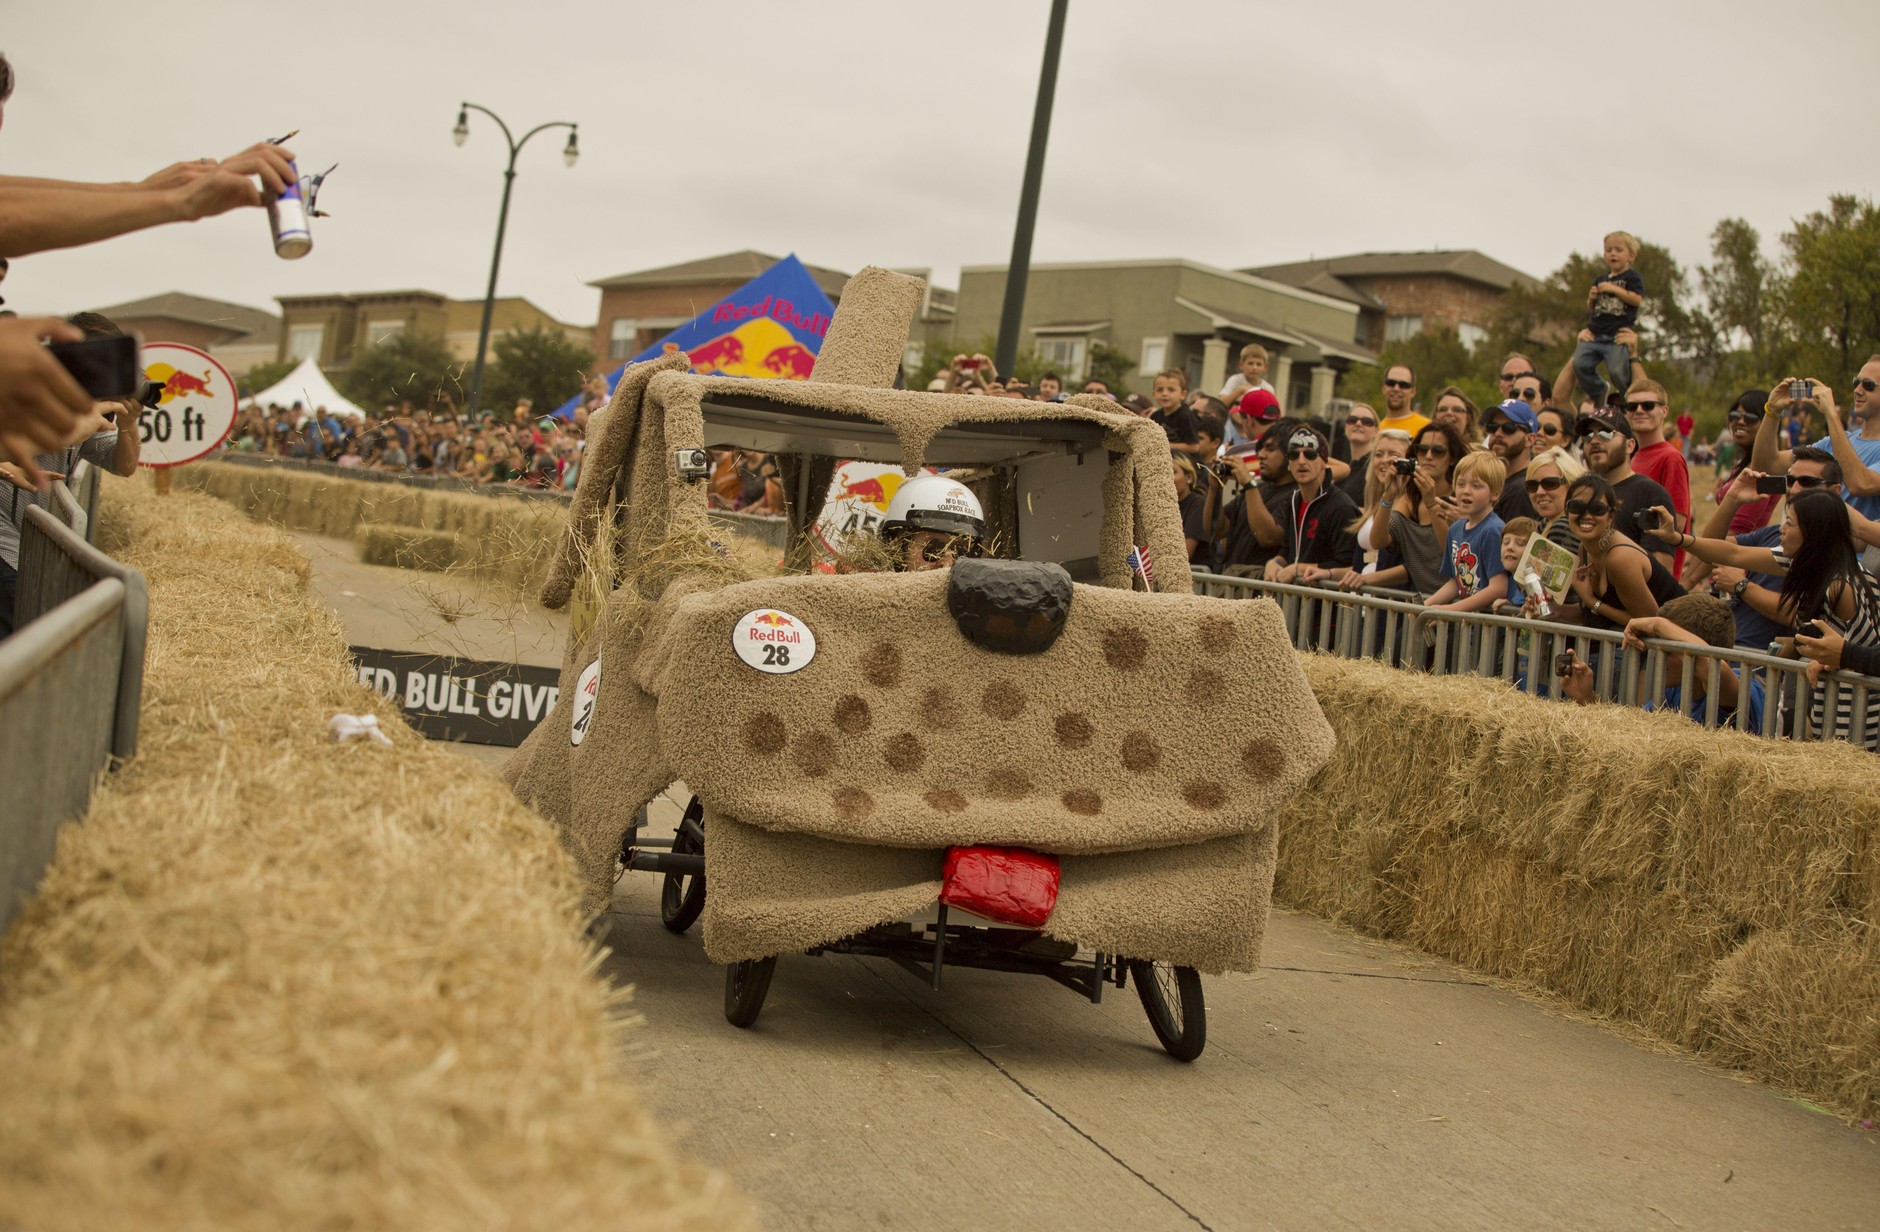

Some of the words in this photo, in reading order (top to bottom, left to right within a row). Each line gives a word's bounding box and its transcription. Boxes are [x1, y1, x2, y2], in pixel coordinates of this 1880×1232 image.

[713, 295, 773, 324] Red
[772, 298, 834, 338] Bull
[182, 406, 205, 442] ft
[937, 504, 964, 513] SOAPBOX
[964, 507, 976, 517] RACE
[749, 627, 775, 642] Red
[776, 629, 801, 644] Bull
[762, 643, 791, 666] 28
[404, 671, 480, 716] BULL
